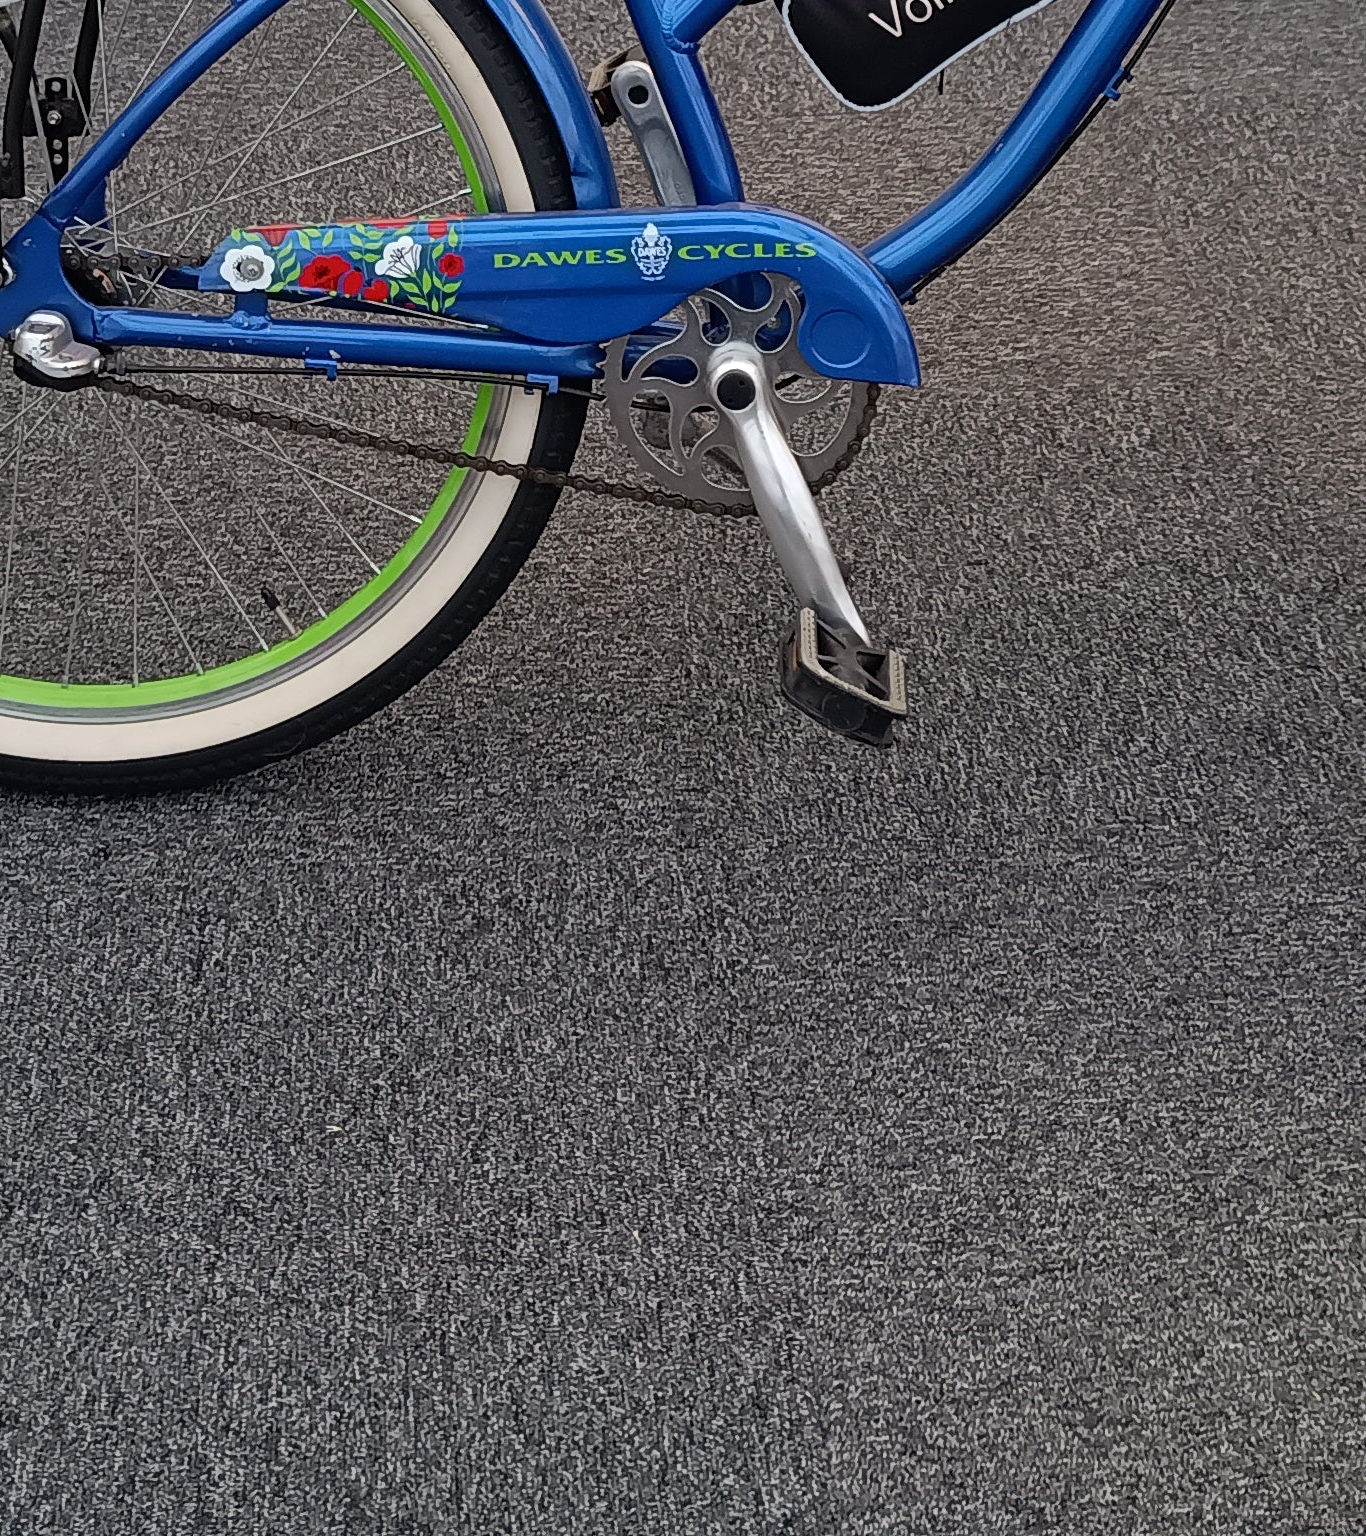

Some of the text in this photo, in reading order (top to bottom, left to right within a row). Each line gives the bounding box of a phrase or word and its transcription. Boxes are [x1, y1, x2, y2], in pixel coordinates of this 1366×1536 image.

[493, 242, 818, 269] DAWES CYCLES
[638, 245, 667, 258] DAWES
